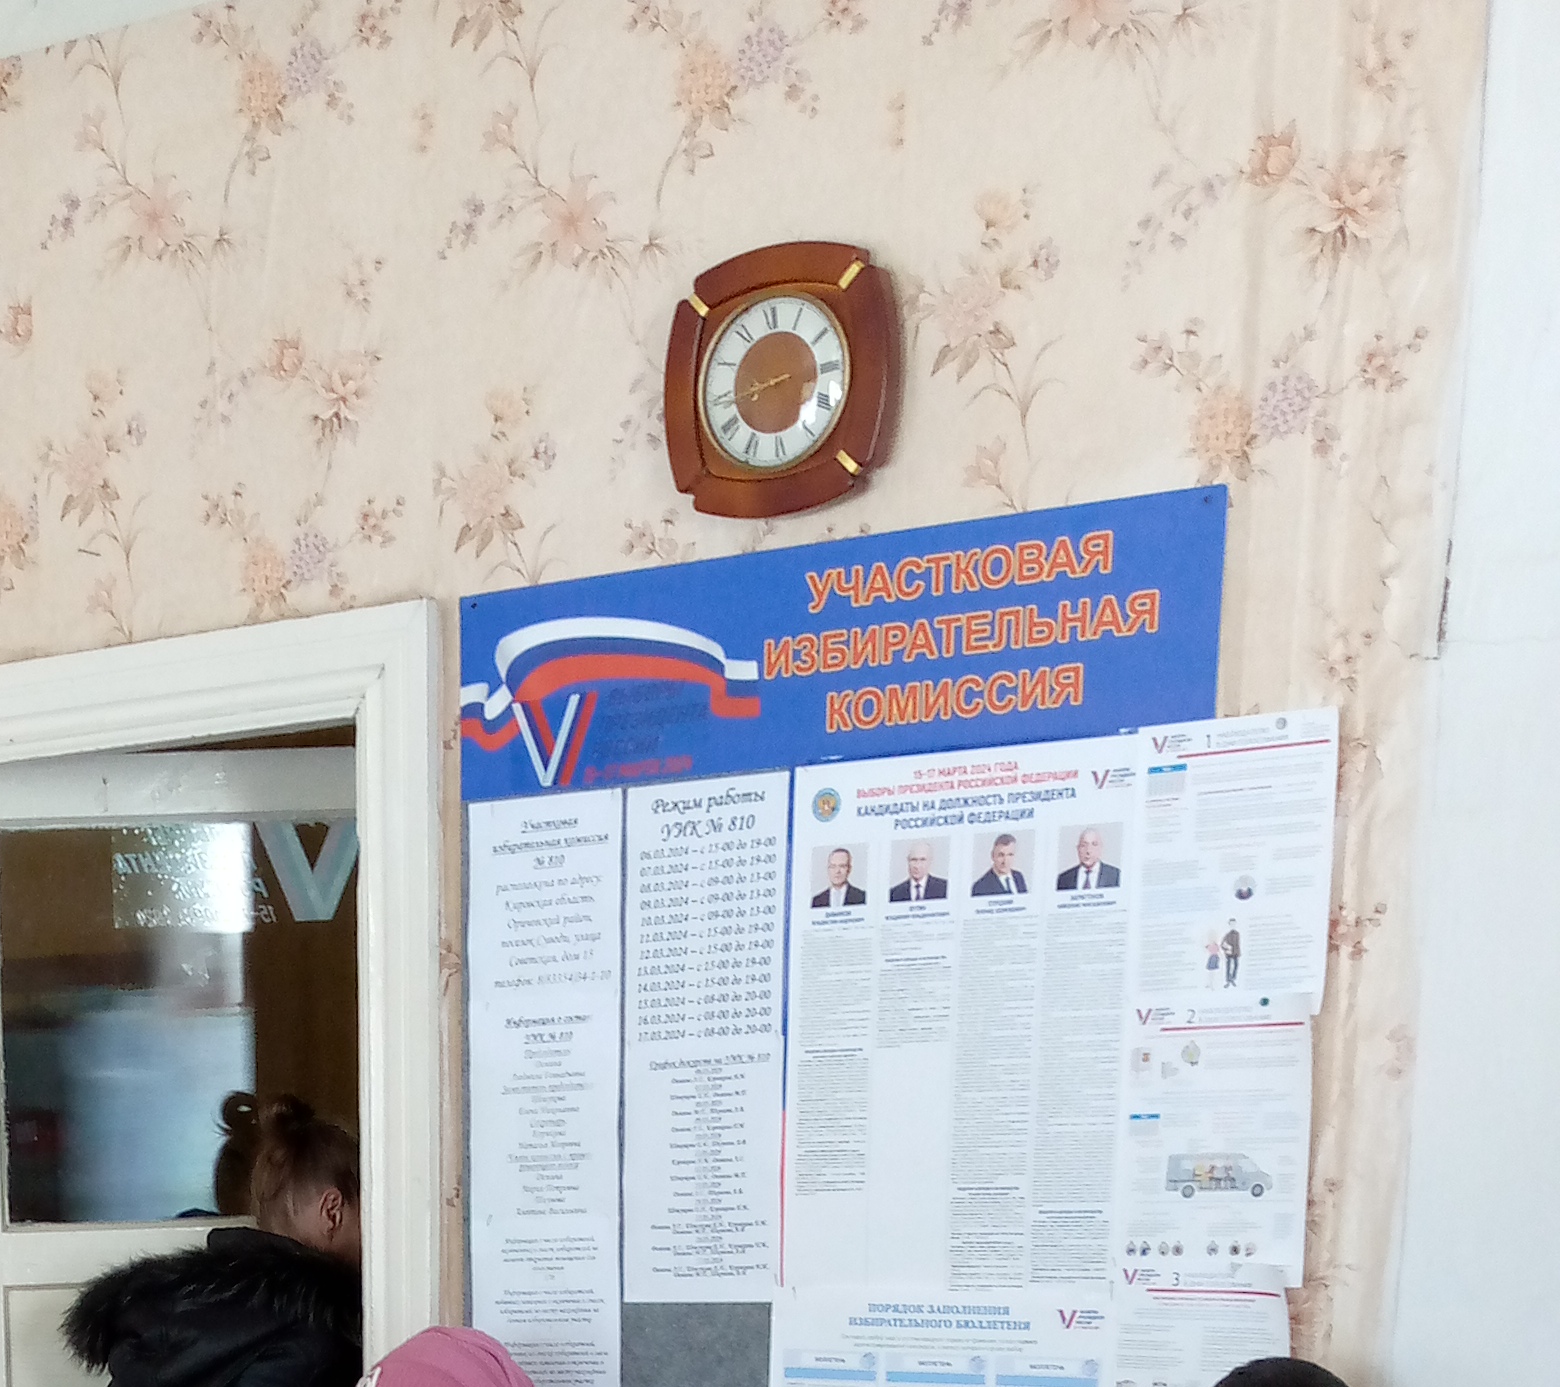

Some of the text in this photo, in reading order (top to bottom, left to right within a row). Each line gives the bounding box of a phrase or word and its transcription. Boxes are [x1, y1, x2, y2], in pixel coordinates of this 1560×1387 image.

[806, 530, 1114, 612] УЧАСТКОВАЯ
[763, 589, 1160, 680] ИЗБИРАТЕЛЬНАЯ
[825, 662, 1084, 733] КОМИССИЯ
[651, 787, 766, 815] Режим работы
[856, 787, 1076, 817] КАНДИДАТЫ НА ДОЛЖНОСТЬ ПРЕЗИДЕНТА
[728, 814, 756, 831] 810
[894, 807, 1035, 830] РОССИЙСКОЙ ФЕДЕРАЦИИ
[1186, 1009, 1197, 1024] 2
[1172, 1272, 1181, 1286] 3
[868, 1303, 925, 1314] ПОРЯДОК
